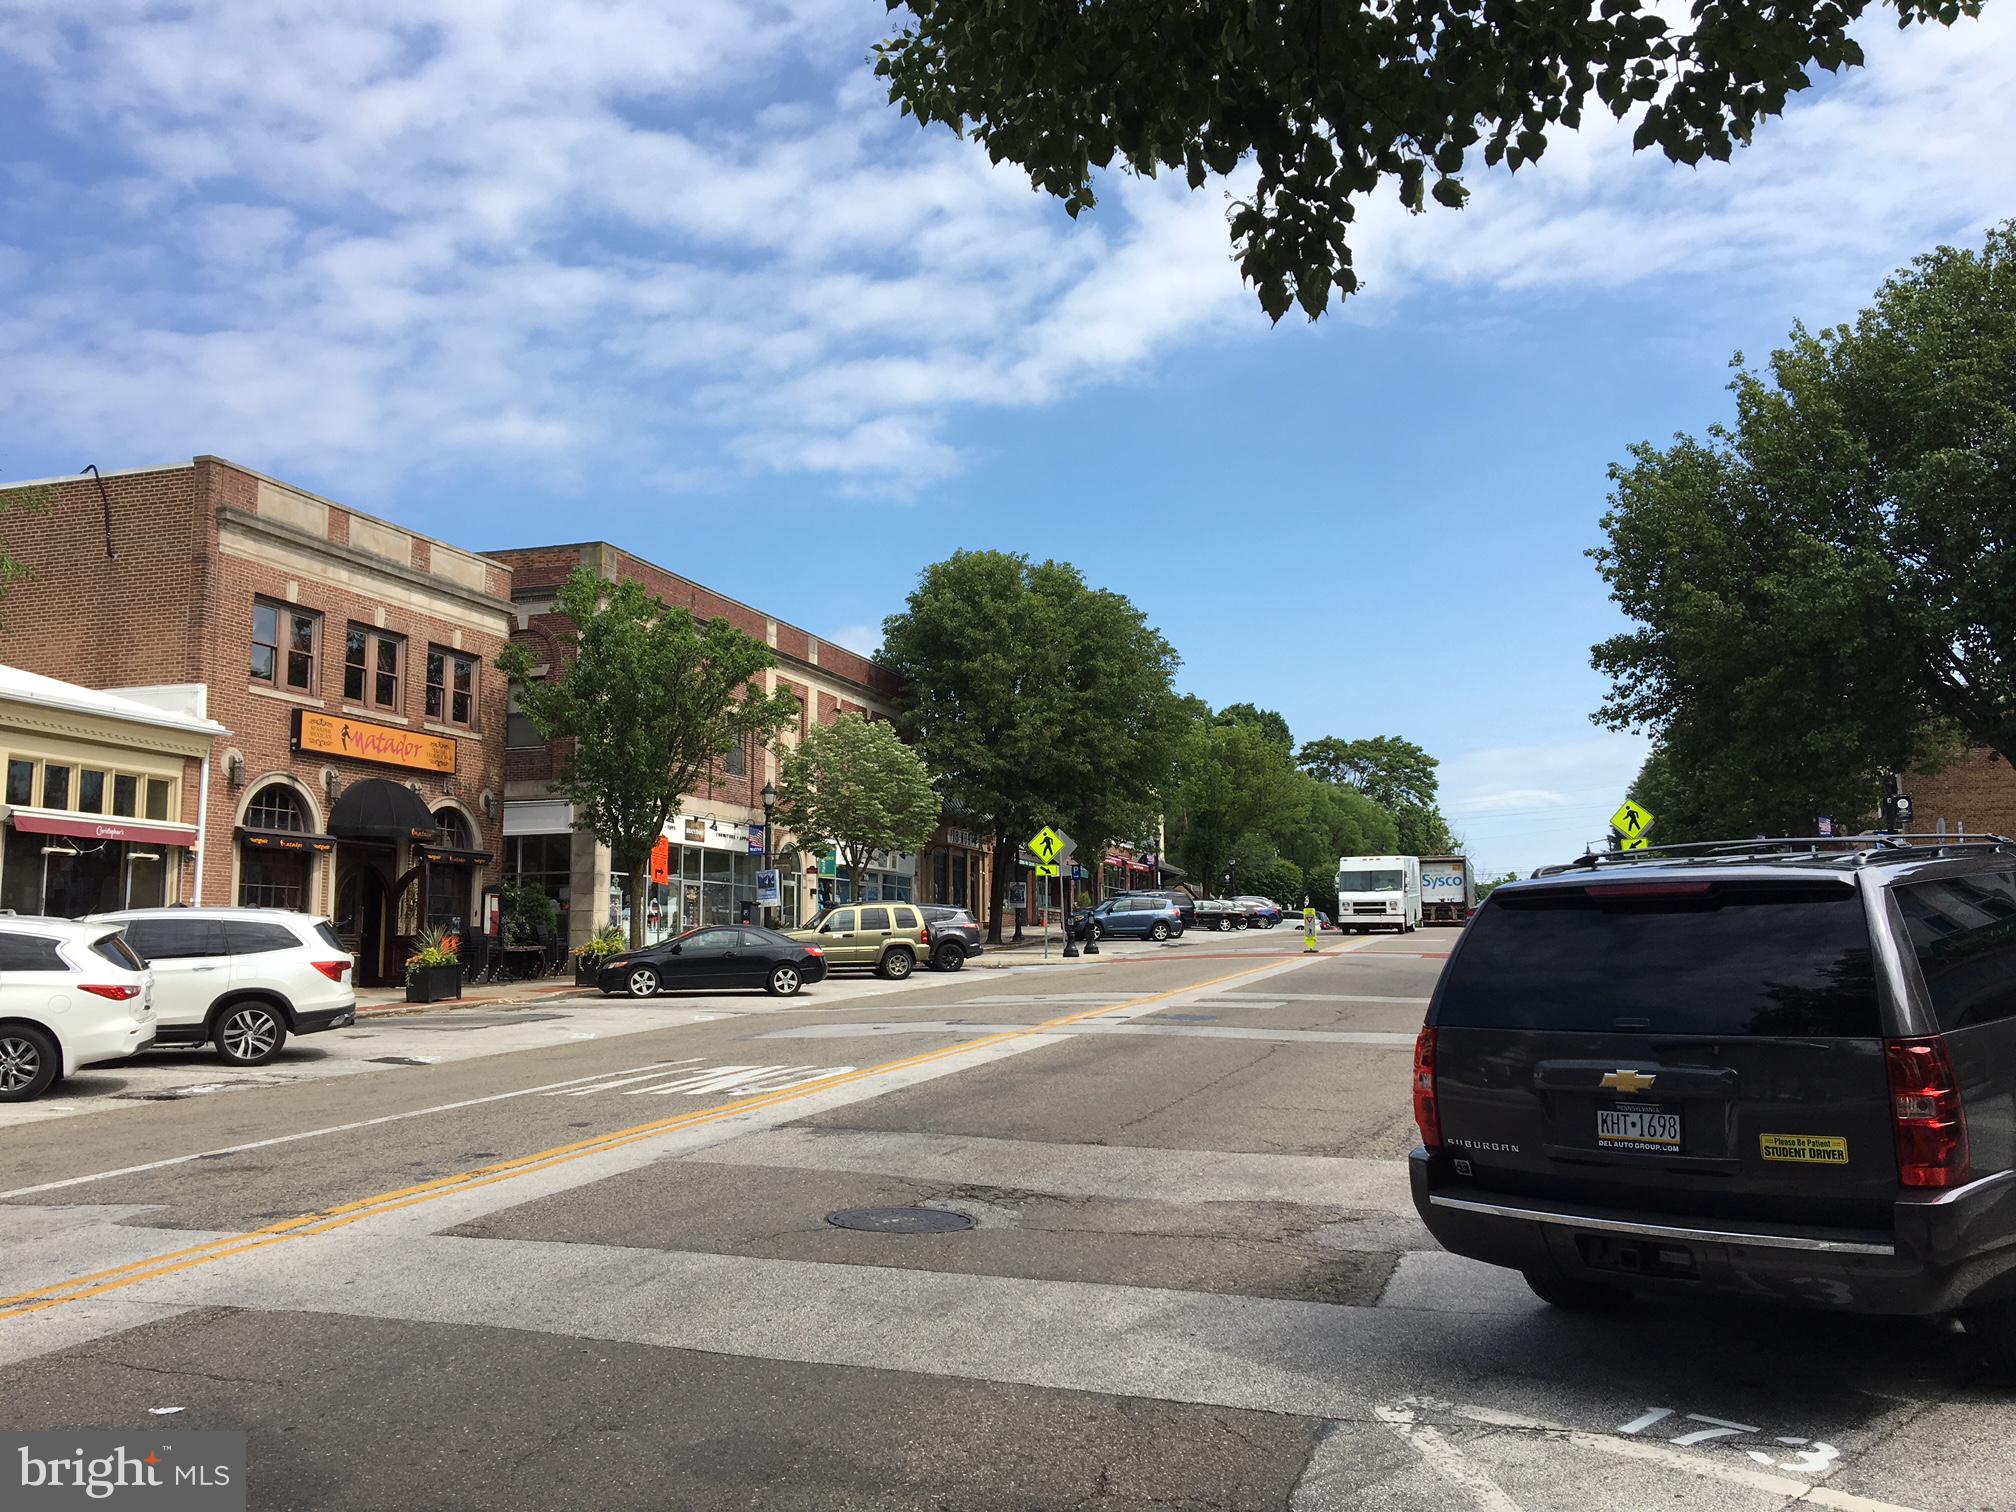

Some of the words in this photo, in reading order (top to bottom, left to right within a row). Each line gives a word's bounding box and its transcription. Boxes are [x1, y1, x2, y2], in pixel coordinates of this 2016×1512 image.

[350, 730, 423, 762] Matador
[1422, 873, 1463, 890] Sysco
[1616, 1105, 1660, 1113] PENNSYLVANIA
[1447, 1138, 1520, 1153] SUBURBAN
[1634, 1143, 1679, 1152] GROUP.COM
[1774, 1138, 1796, 1147] Please
[1797, 1139, 1806, 1147] Be
[1807, 1139, 1831, 1148] Patient
[1764, 1146, 1807, 1158] STUDENT
[1809, 1148, 1845, 1161] DRIVER
